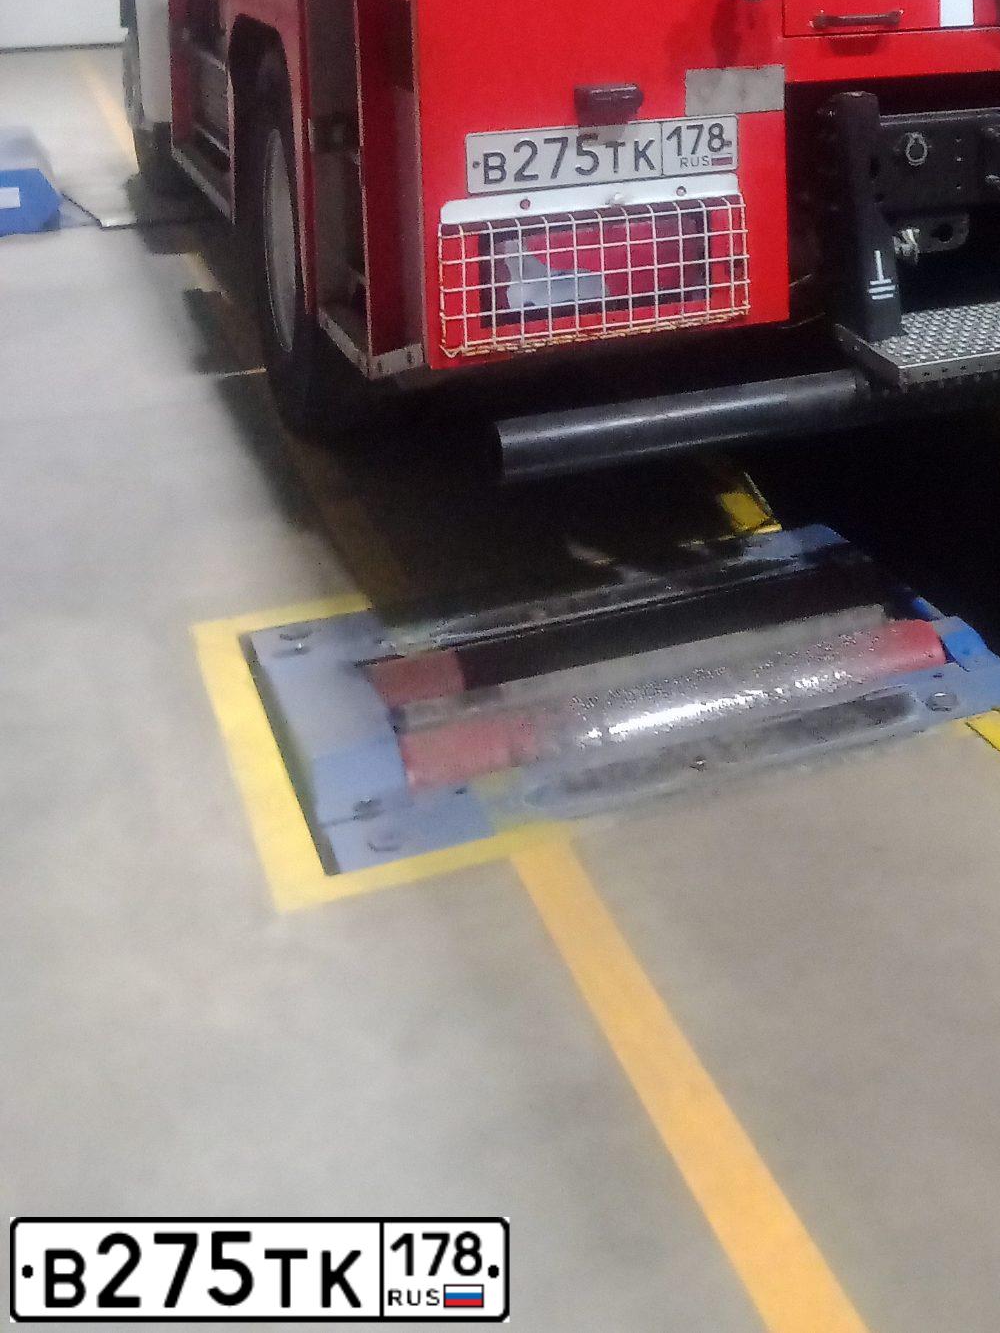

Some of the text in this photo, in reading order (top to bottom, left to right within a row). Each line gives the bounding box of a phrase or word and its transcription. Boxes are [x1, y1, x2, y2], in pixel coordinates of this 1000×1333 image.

[483, 123, 725, 185] В275ТК 178
[679, 156, 710, 169] RUS
